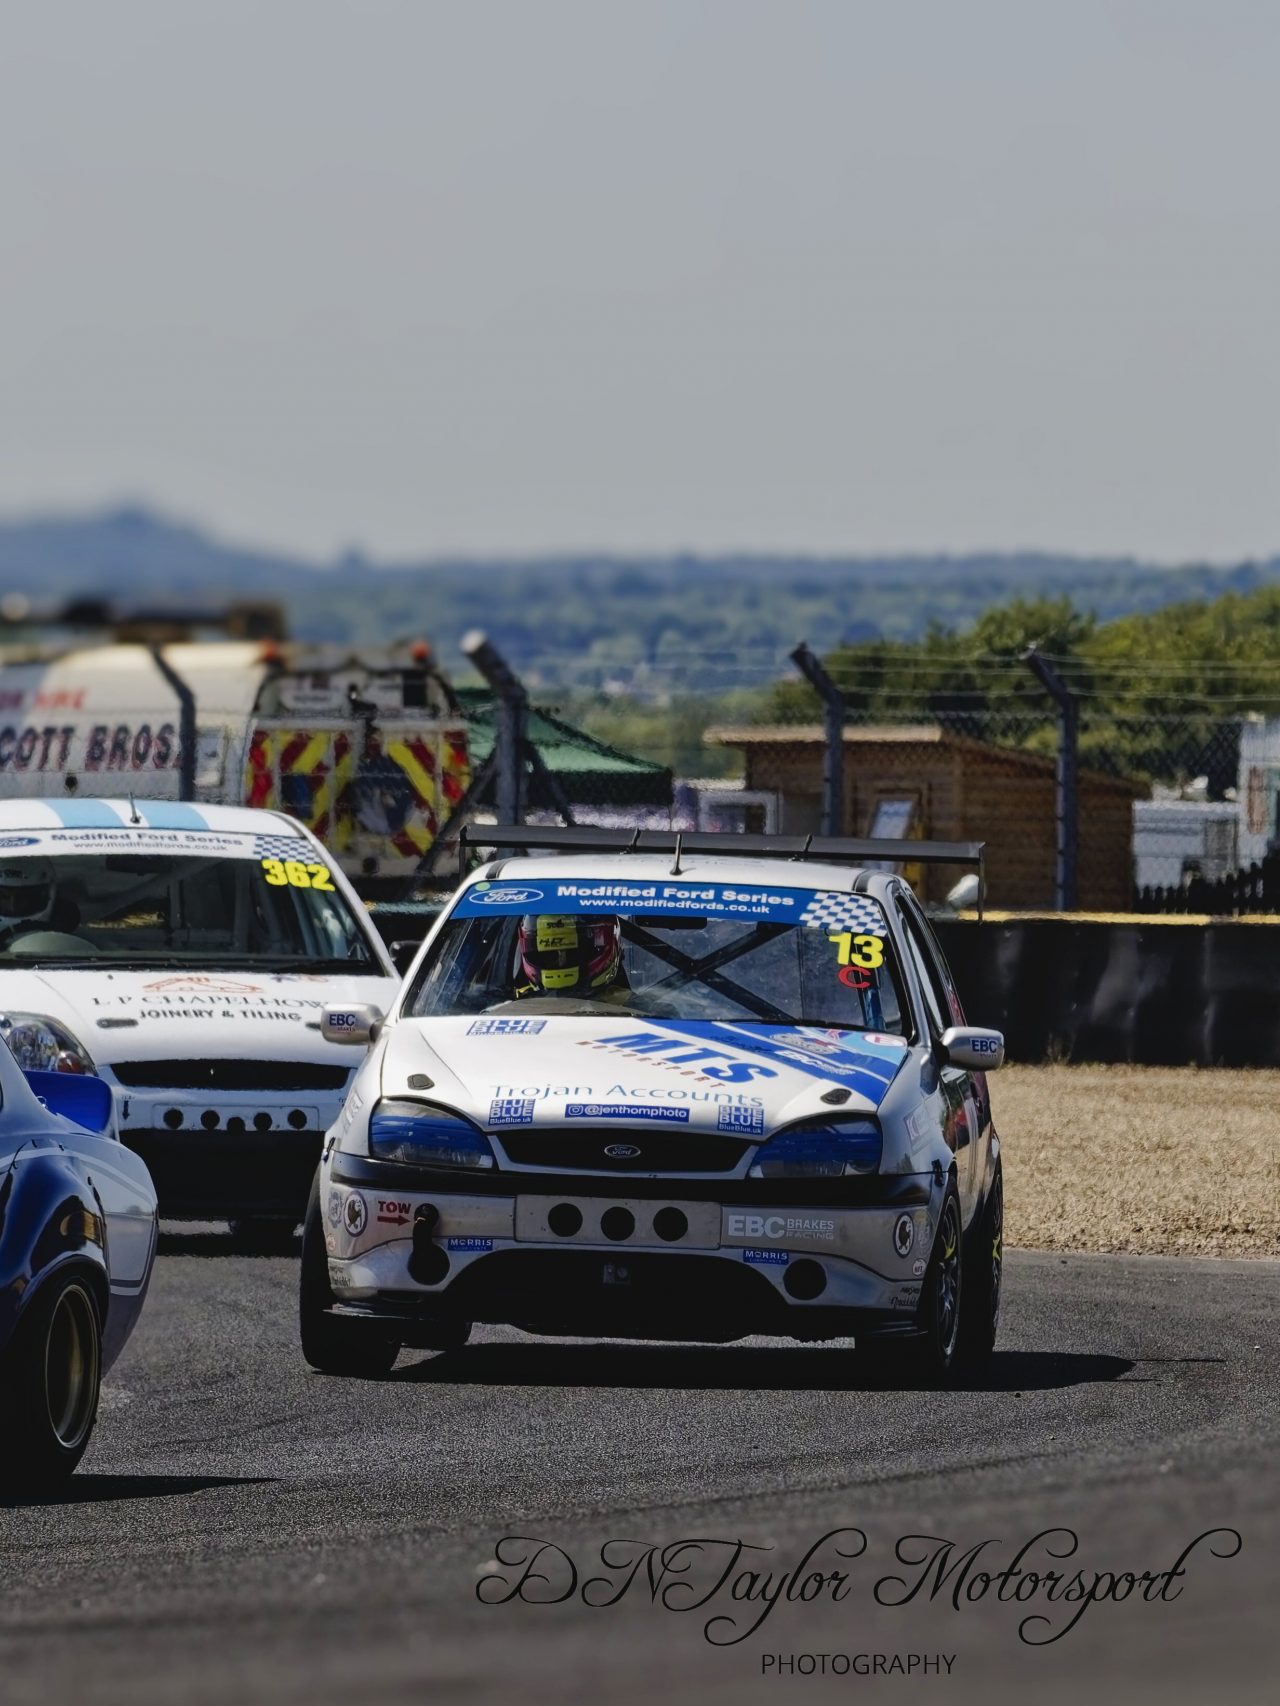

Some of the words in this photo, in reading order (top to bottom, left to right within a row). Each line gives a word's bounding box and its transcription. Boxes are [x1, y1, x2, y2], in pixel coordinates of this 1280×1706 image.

[51, 833, 131, 842] Modified
[137, 832, 177, 842] Ford
[184, 835, 244, 846] Series
[261, 859, 336, 892] 362
[484, 888, 528, 902] Ford
[557, 886, 656, 898] Modified
[663, 887, 716, 900] Ford
[721, 890, 795, 906] Series
[579, 899, 771, 915] www.modifiedfords.co.uk
[828, 932, 885, 969] 13
[838, 965, 871, 989] C
[140, 1008, 214, 1020] JOINERY
[221, 1009, 234, 1019] &
[240, 1009, 302, 1022] TILING
[329, 1013, 356, 1027] EBC
[973, 1039, 998, 1053] EBC
[590, 1032, 779, 1083] MTS
[488, 1083, 594, 1099] Trojan
[606, 1084, 764, 1108] Accounts
[492, 1098, 536, 1108] BLUE
[490, 1107, 534, 1118] BLUE
[584, 1104, 687, 1119] @jenthomphoto
[719, 1105, 764, 1117] BLUE
[489, 1116, 532, 1125] BlueBlue.uk
[719, 1113, 763, 1128] BLUE
[718, 1123, 762, 1135] BlueBlue.uk
[377, 1200, 412, 1215] TOW
[728, 1214, 785, 1240] EBC
[787, 1217, 835, 1231] BRAKES
[450, 1238, 492, 1247] MORRIS
[744, 1249, 789, 1261] MORRIS
